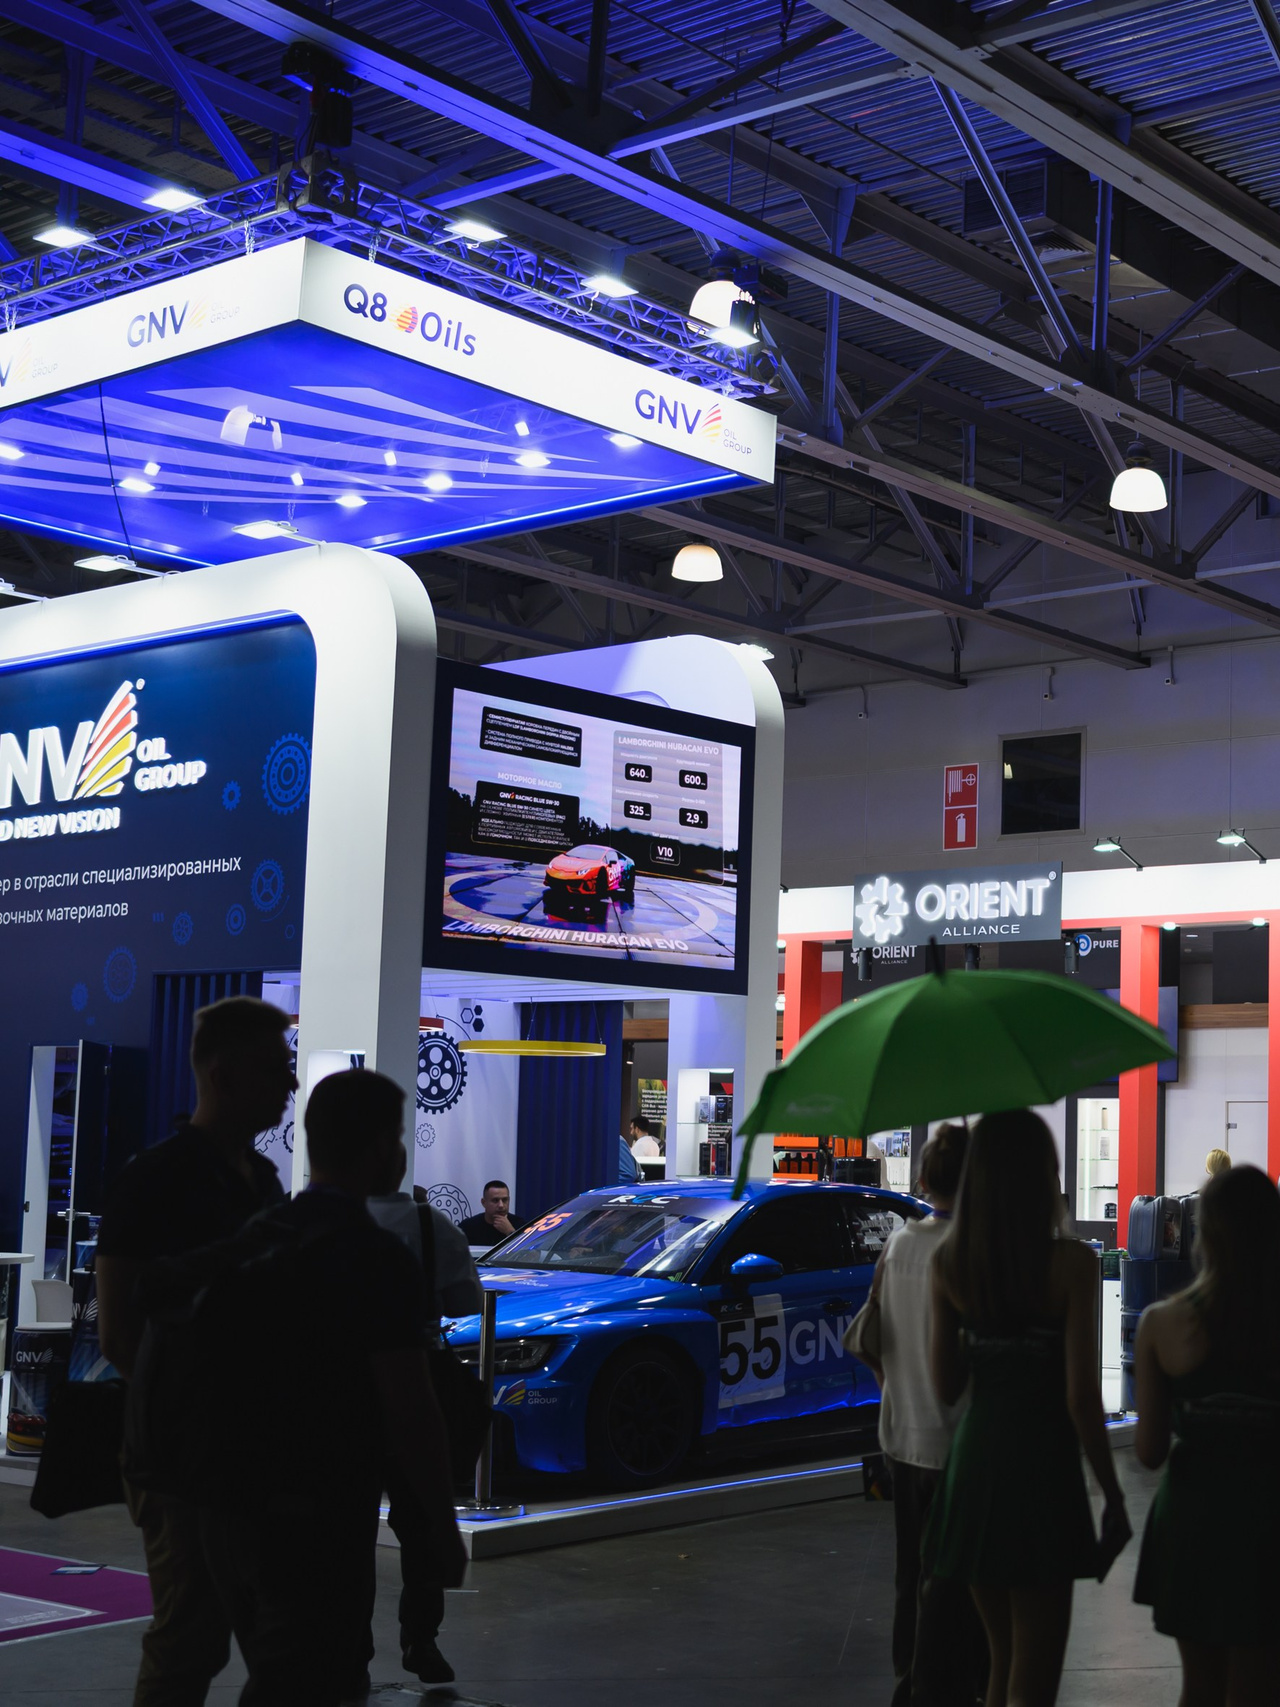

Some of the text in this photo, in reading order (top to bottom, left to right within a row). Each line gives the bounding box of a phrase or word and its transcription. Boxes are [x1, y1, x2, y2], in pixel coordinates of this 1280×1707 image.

[127, 299, 189, 348] GNV
[210, 306, 240, 324] GROUP
[344, 283, 477, 356] Q8 Oils
[635, 389, 702, 435] GNV
[723, 428, 737, 441] OIL
[722, 438, 752, 455] GROUP
[137, 737, 172, 763] OIL
[618, 736, 720, 756] LAMBORGHINI HURACAN EVO
[134, 760, 207, 791] GROUP
[497, 771, 563, 790] МОТОРНОЕ МАСЛО
[629, 767, 646, 779] 640
[684, 774, 701, 786] 600
[629, 804, 645, 816] 325
[686, 812, 700, 824] 2,9
[13, 814, 58, 839] NEW
[58, 807, 121, 834] VISION
[657, 845, 673, 858] V10
[14, 877, 22, 891] в
[24, 872, 79, 893] отрасли
[82, 856, 242, 884] специализированных
[915, 878, 1050, 921] ORIENT
[46, 902, 129, 923] материалов
[443, 920, 690, 952] LAMBORGHINI HURACAN EVO
[942, 924, 1021, 937] ALLIANCE
[872, 945, 918, 959] ORIENT
[1093, 939, 1119, 949] PURE
[15, 1350, 43, 1364] GNV
[719, 1315, 782, 1386] 55
[527, 1397, 558, 1405] GROUP
